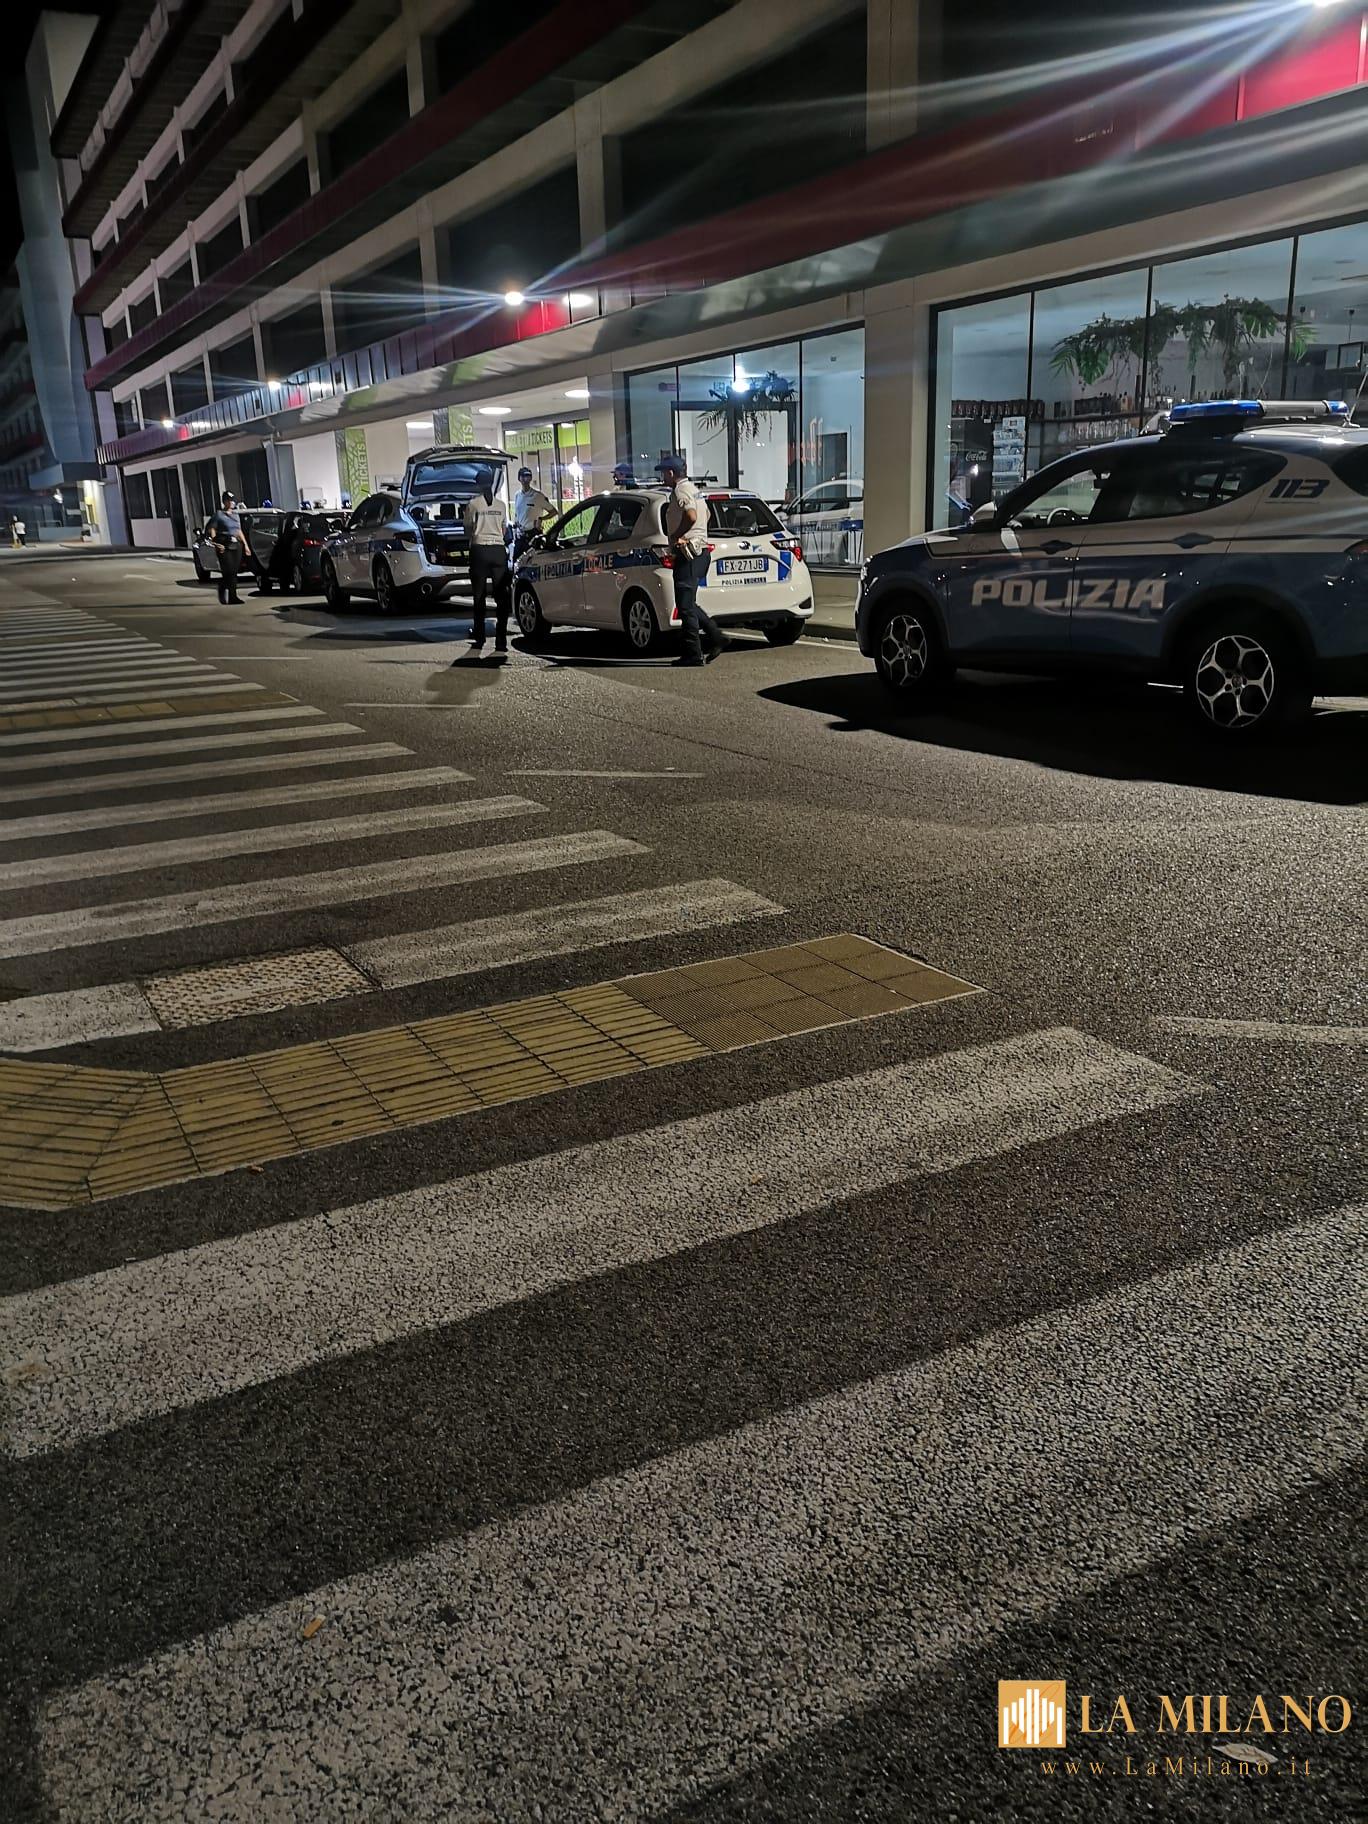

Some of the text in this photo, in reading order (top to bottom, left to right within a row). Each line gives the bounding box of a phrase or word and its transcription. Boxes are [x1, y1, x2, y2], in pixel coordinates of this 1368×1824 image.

[531, 431, 553, 446] TICKETS
[358, 443, 369, 485] TICKETS
[1268, 479, 1330, 498] 113
[545, 554, 614, 579] POLIZIA LOCALE
[971, 579, 1168, 608] POLIZIA
